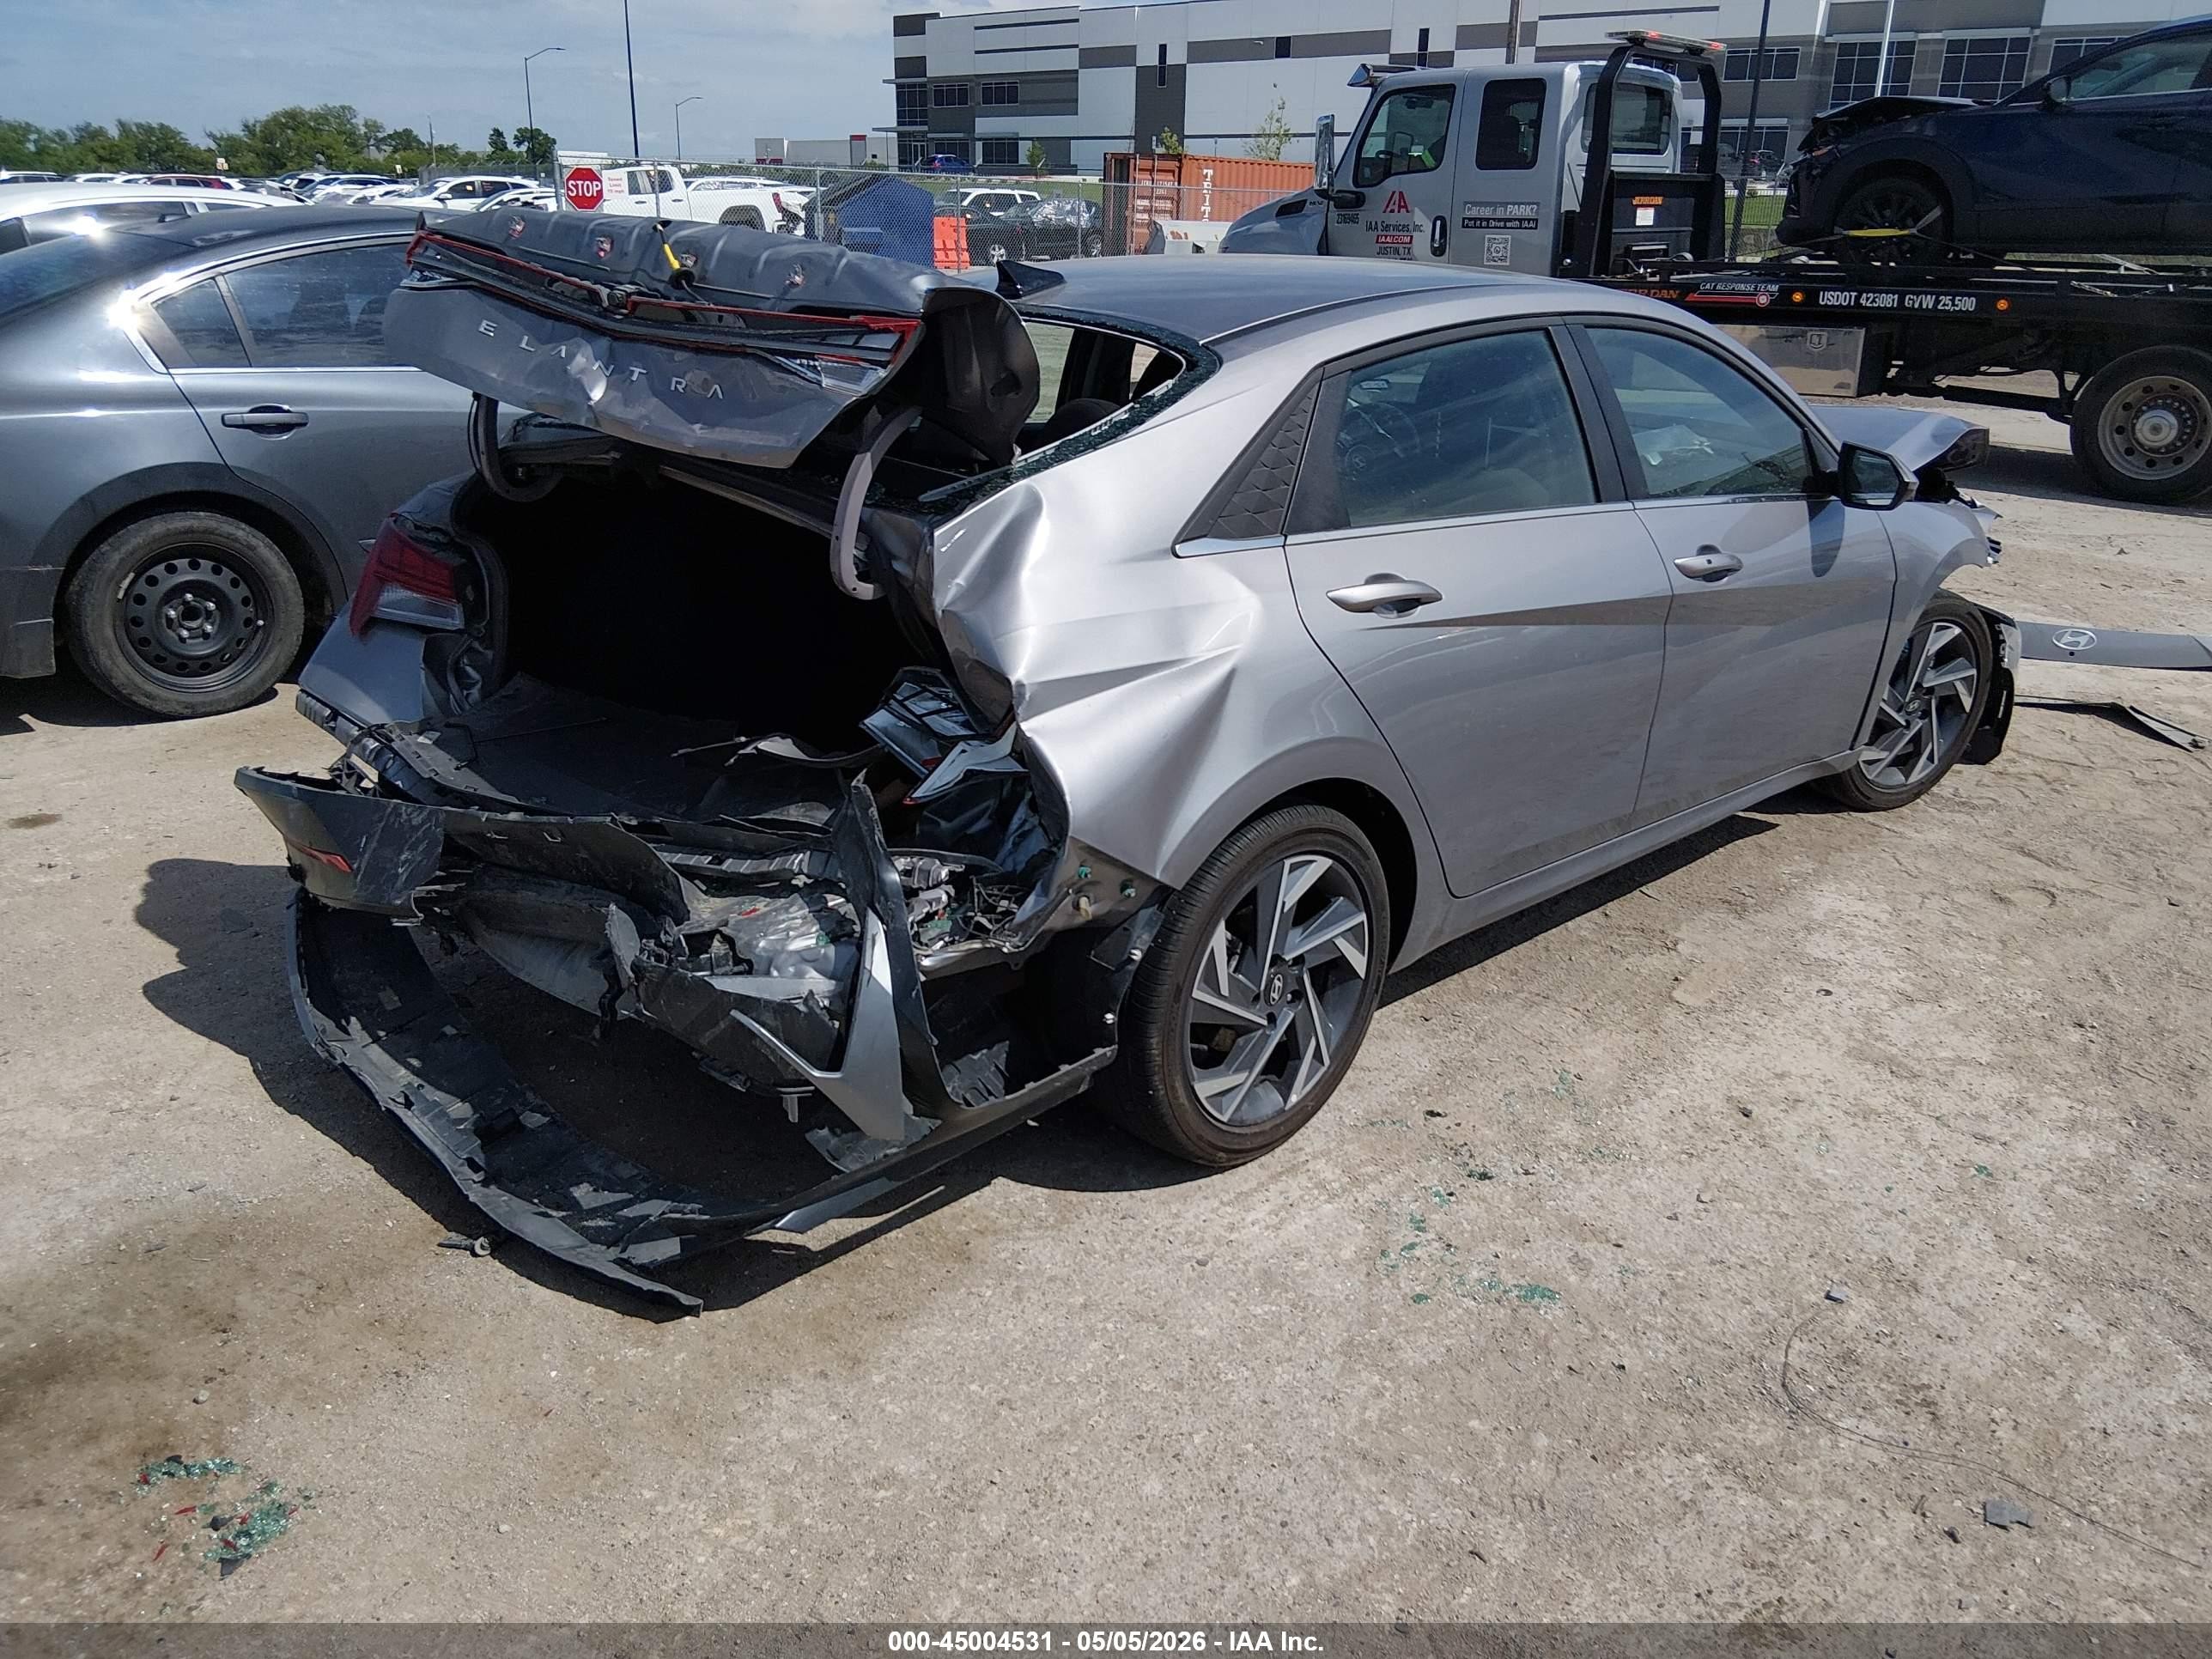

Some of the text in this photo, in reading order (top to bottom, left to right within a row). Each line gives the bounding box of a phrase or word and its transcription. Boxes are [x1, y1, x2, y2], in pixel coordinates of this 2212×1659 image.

[568, 179, 602, 197] STOP
[1201, 168, 1213, 223] TRIT
[1465, 204, 1537, 216] Career in PARK?
[1365, 220, 1378, 233] IAA
[1413, 221, 1425, 233] Inc.
[1464, 219, 1474, 228] Put
[1402, 246, 1412, 256] TX
[1716, 283, 1757, 291] RESPONSE
[1819, 291, 1976, 312] USDOT 423081 GVW 25,500
[478, 319, 724, 399] ELANTRA
